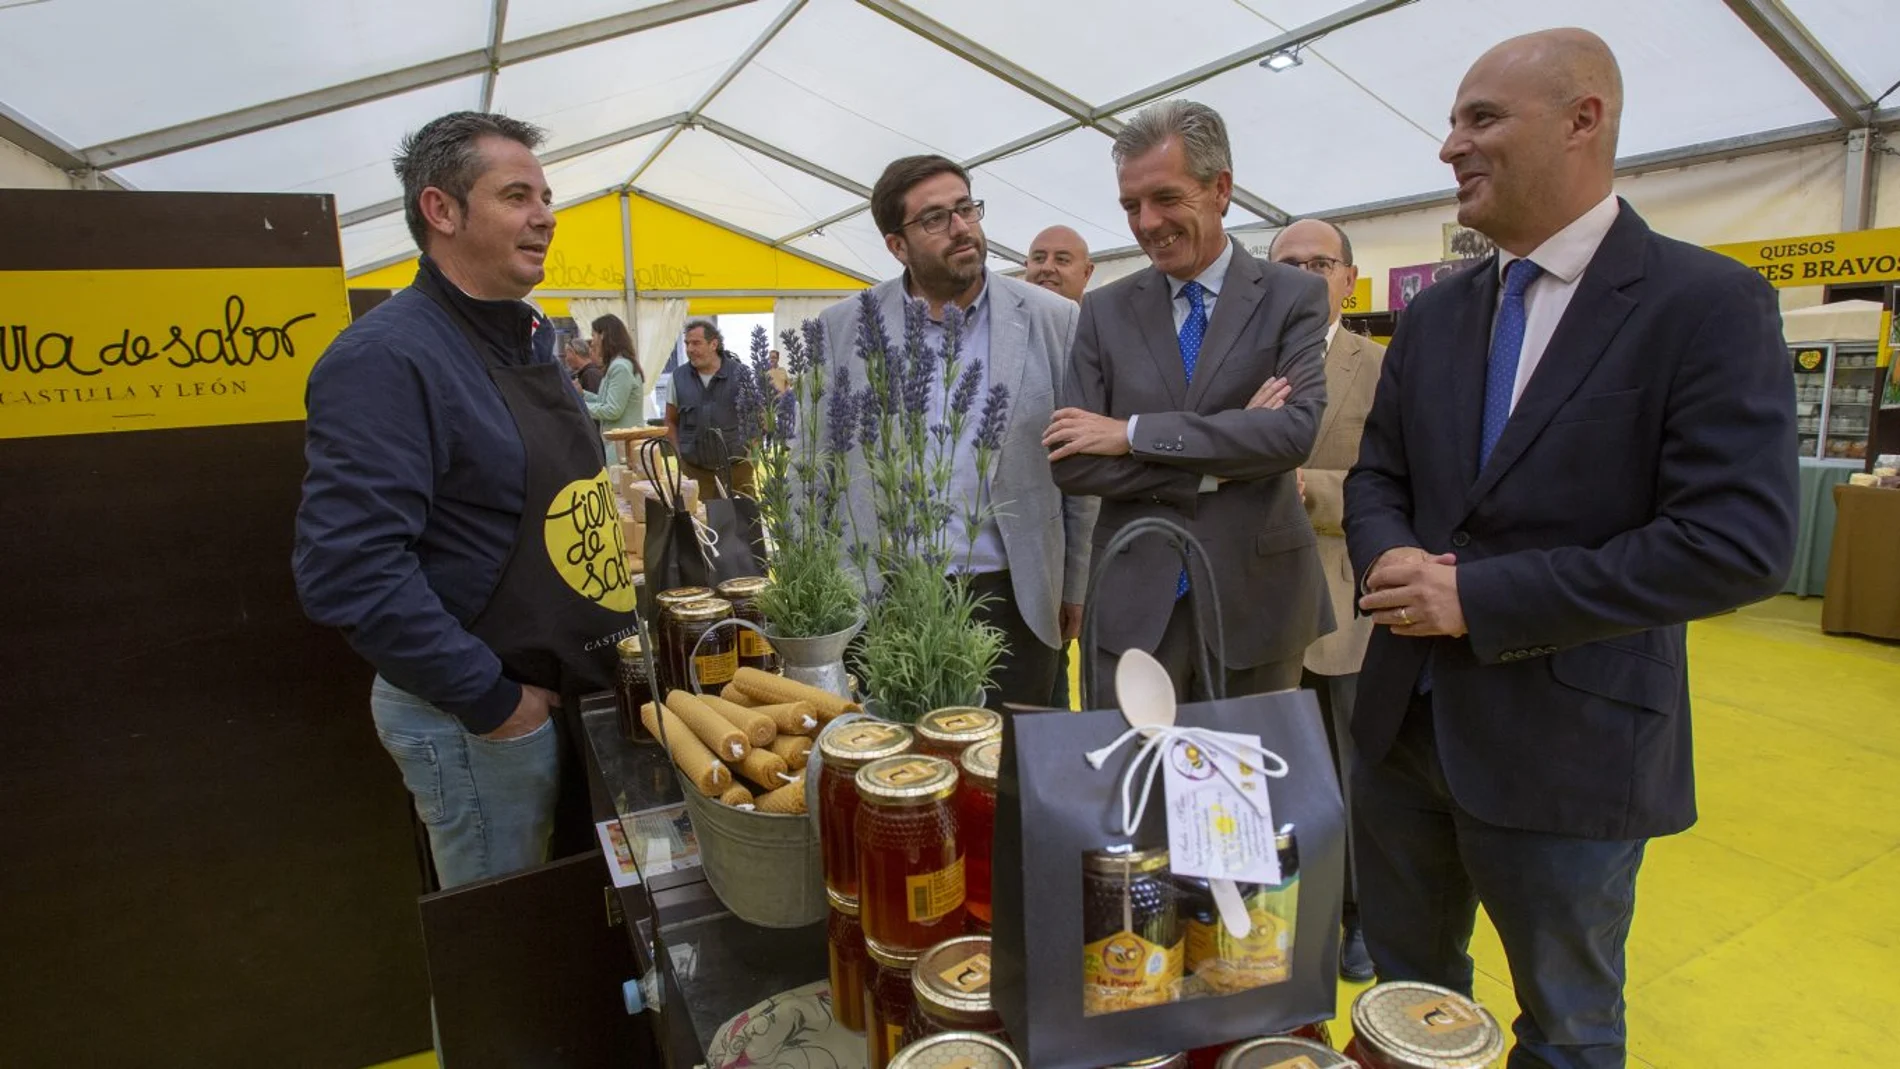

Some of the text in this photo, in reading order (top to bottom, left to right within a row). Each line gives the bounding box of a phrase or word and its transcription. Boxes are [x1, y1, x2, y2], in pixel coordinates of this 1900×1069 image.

[1760, 240, 1835, 261] QUESOS
[98, 329, 159, 366] de
[162, 295, 316, 368] sabor
[150, 383, 164, 399] Y
[177, 377, 248, 398] LEÓN
[567, 530, 605, 566] de
